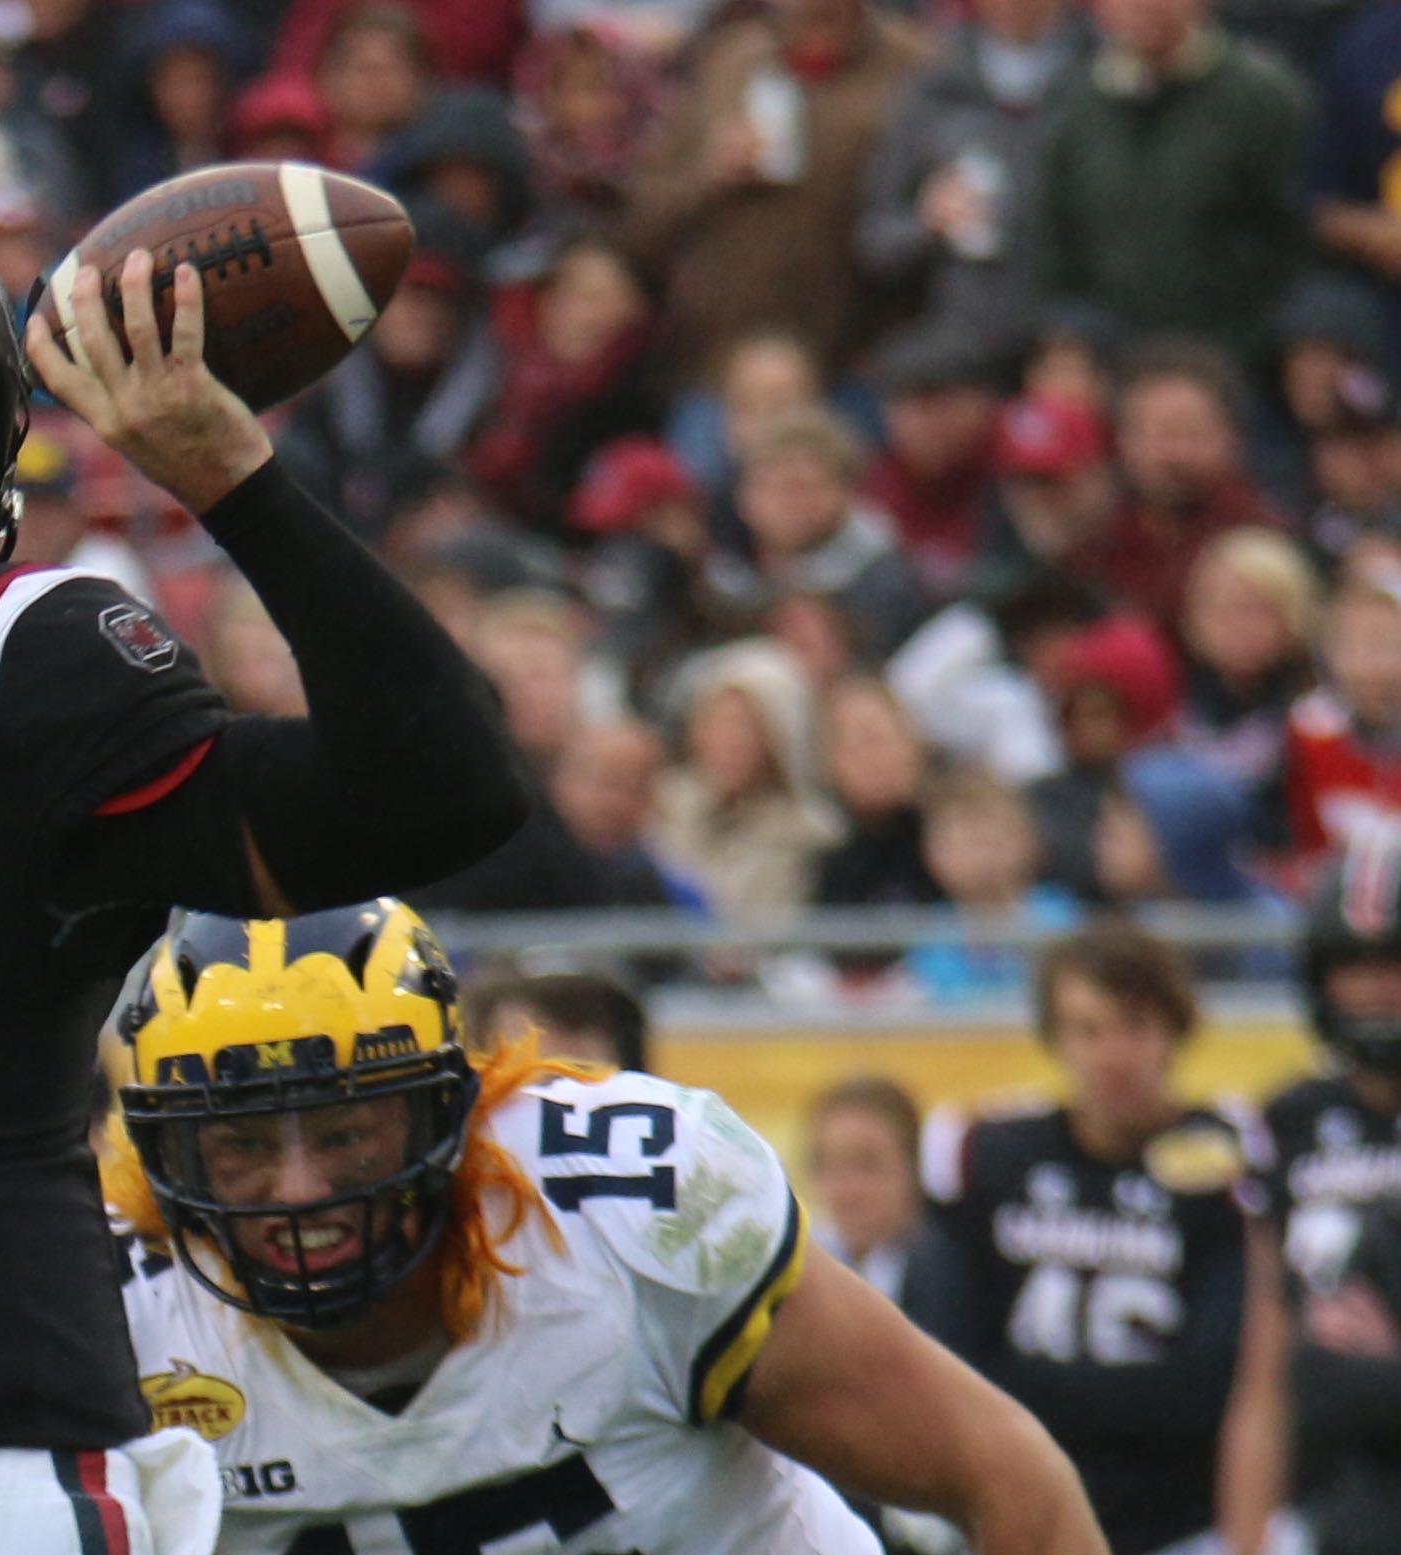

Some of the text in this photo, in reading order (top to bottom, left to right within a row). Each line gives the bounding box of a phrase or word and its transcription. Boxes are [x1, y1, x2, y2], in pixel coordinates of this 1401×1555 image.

[255, 1041, 296, 1070] M
[538, 1100, 676, 1213] 15
[152, 1406, 232, 1424] TBACK
